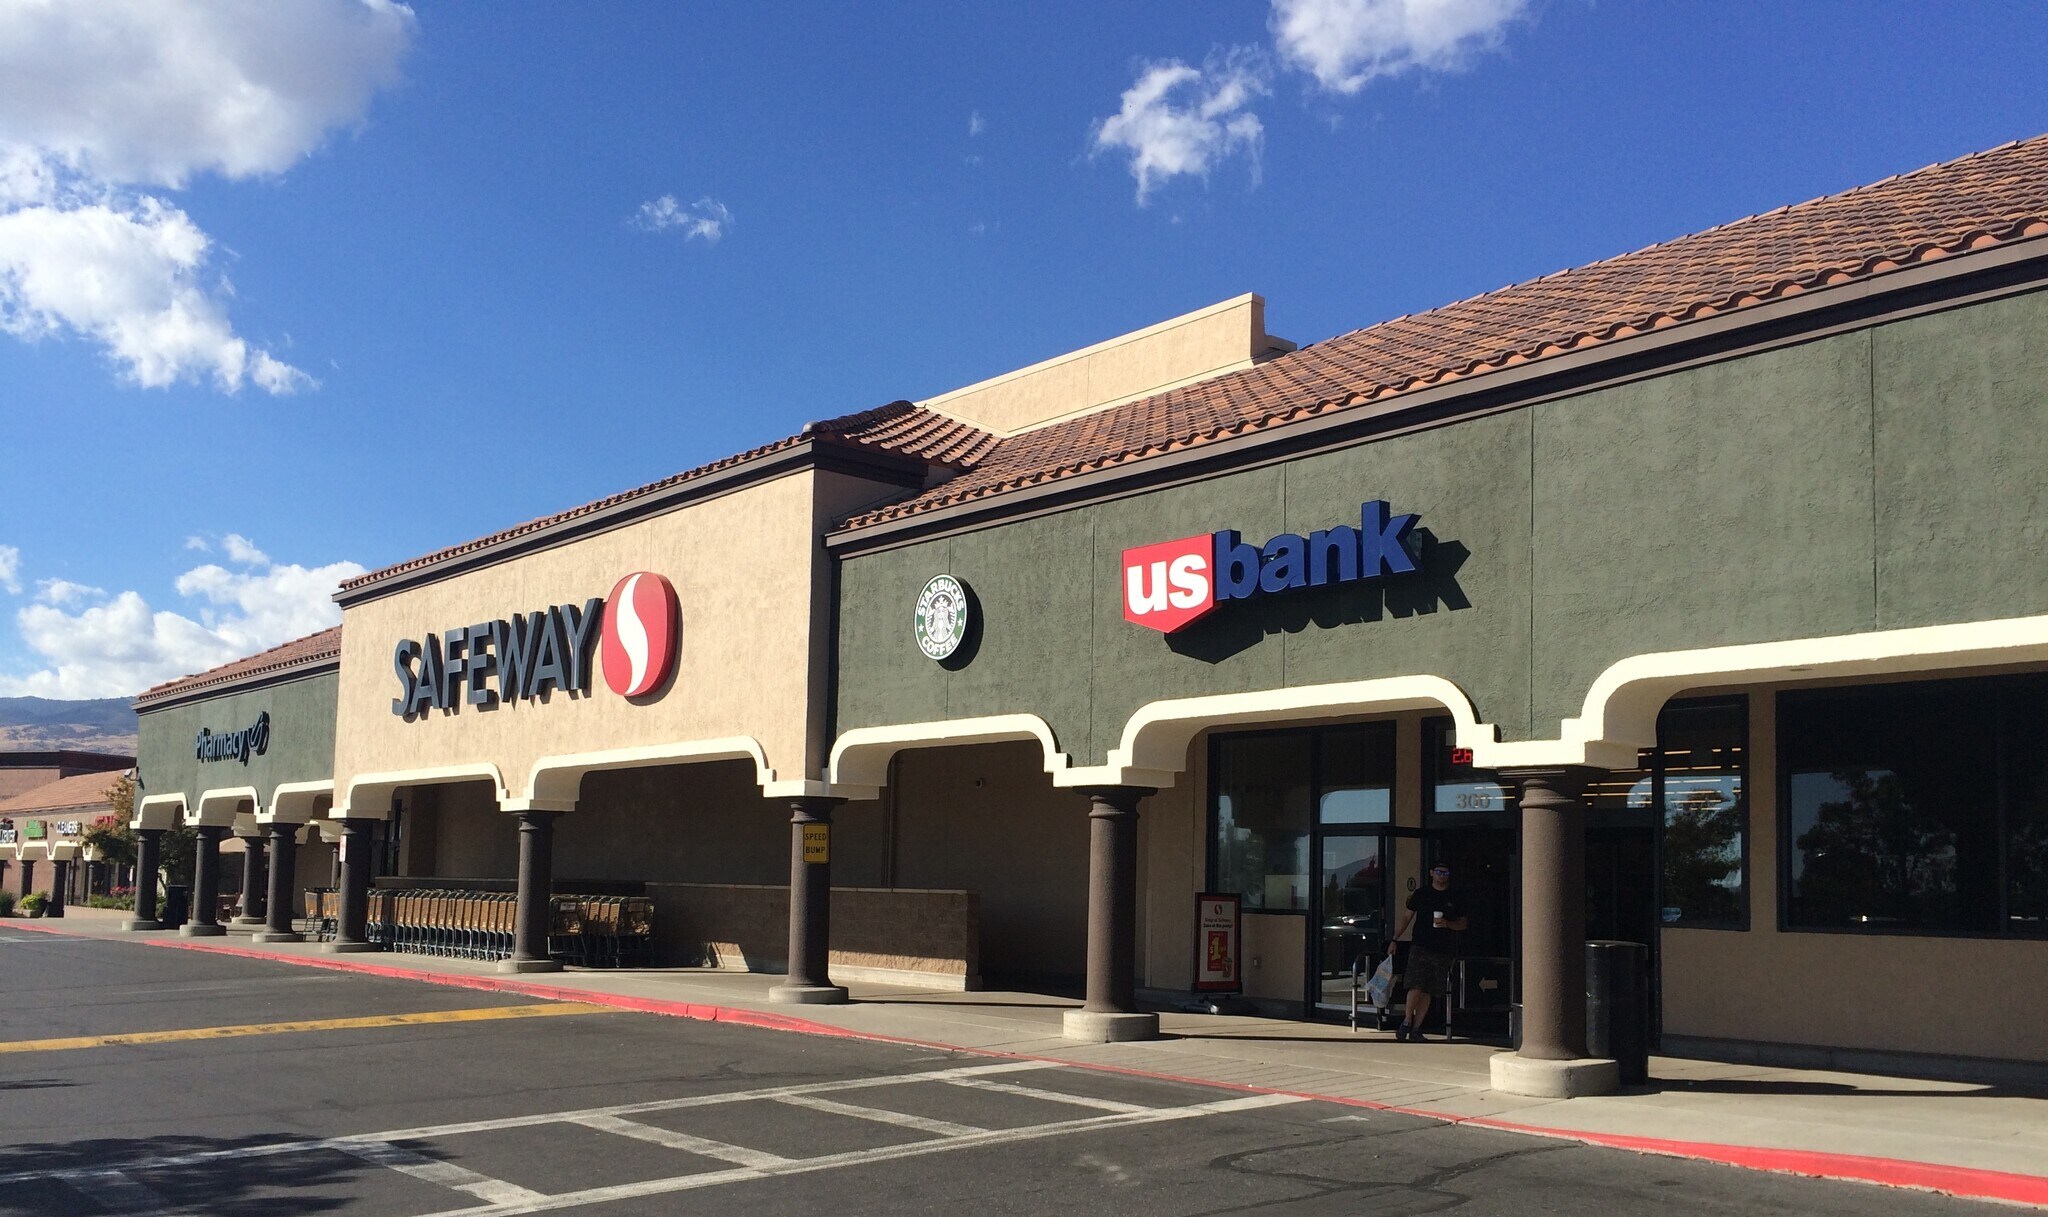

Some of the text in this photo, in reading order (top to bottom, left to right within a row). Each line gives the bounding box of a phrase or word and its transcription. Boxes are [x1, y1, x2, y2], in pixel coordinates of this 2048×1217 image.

[1215, 500, 1419, 601] bank
[918, 579, 964, 616] STARBUCKS
[392, 598, 603, 716] SAFEWAY
[922, 634, 957, 655] COFFEE
[196, 728, 244, 762] Pharmacy
[805, 833, 826, 841] SPEED
[805, 846, 826, 854] BUMP
